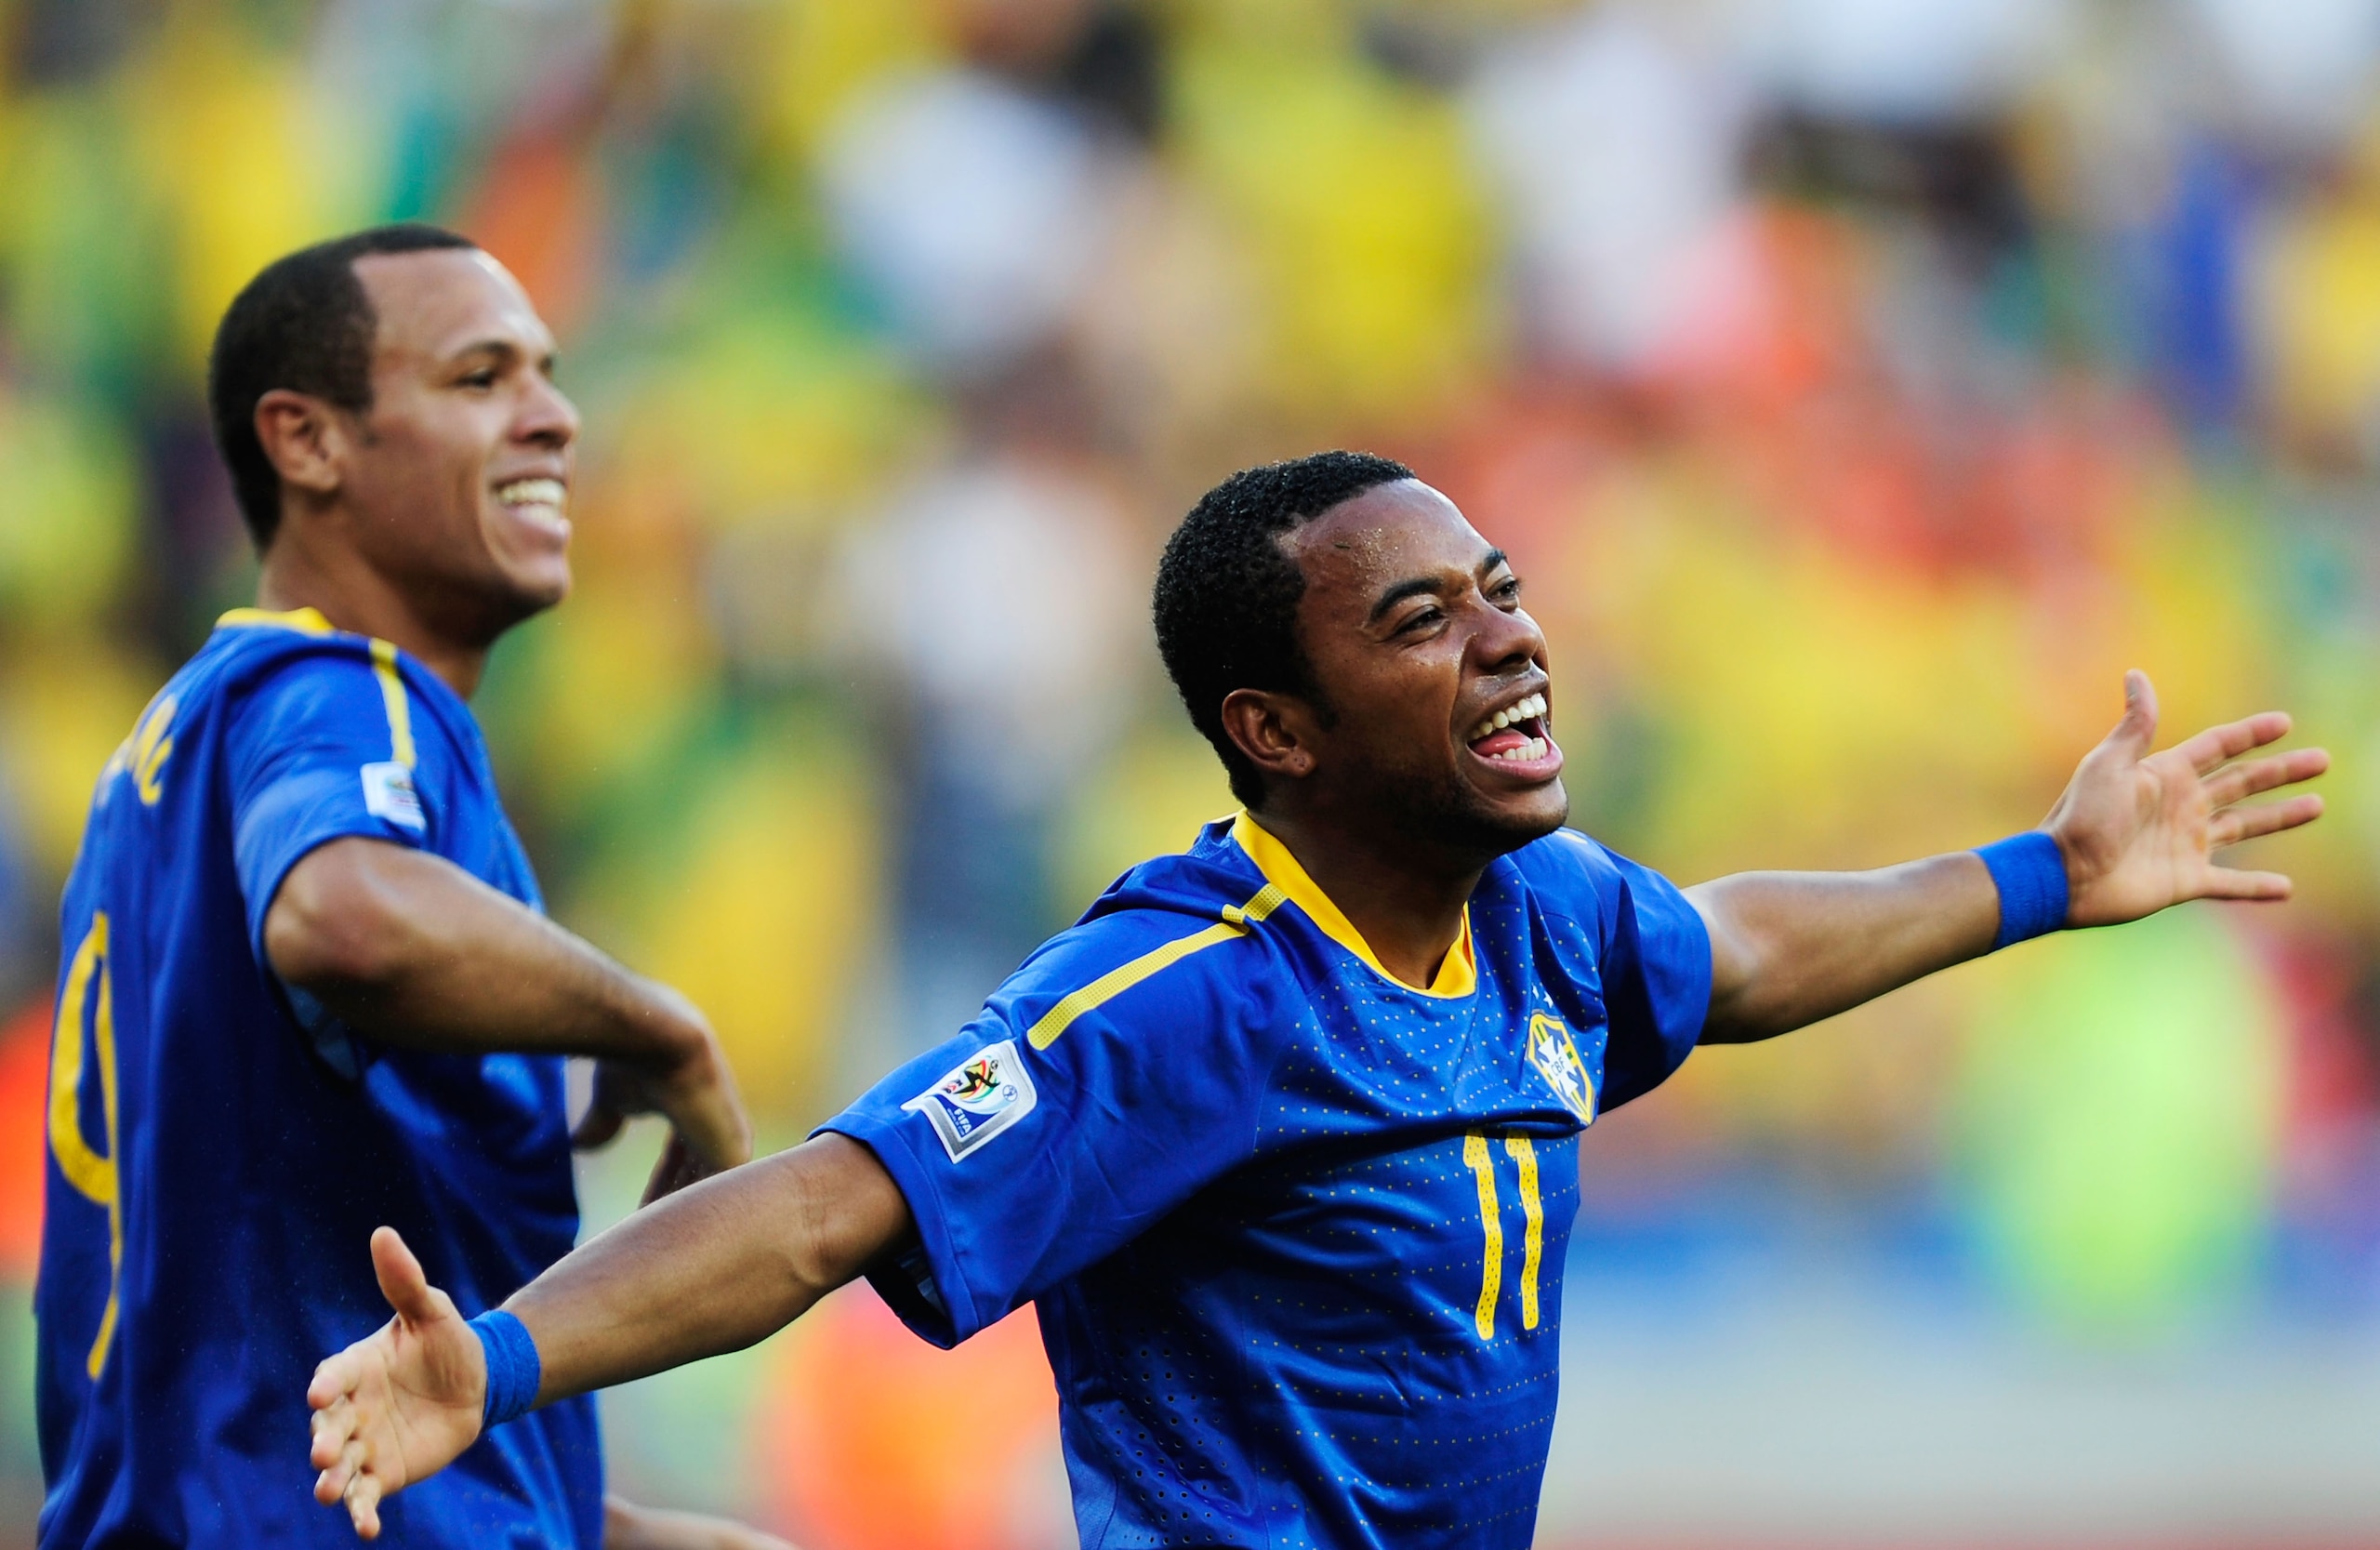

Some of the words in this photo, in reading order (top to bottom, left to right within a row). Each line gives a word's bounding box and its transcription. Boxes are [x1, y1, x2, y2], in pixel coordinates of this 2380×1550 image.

[954, 1107, 972, 1133] FIFA
[1551, 1056, 1566, 1076] CBF
[48, 910, 123, 1382] 9
[1462, 1127, 1544, 1341] 11
